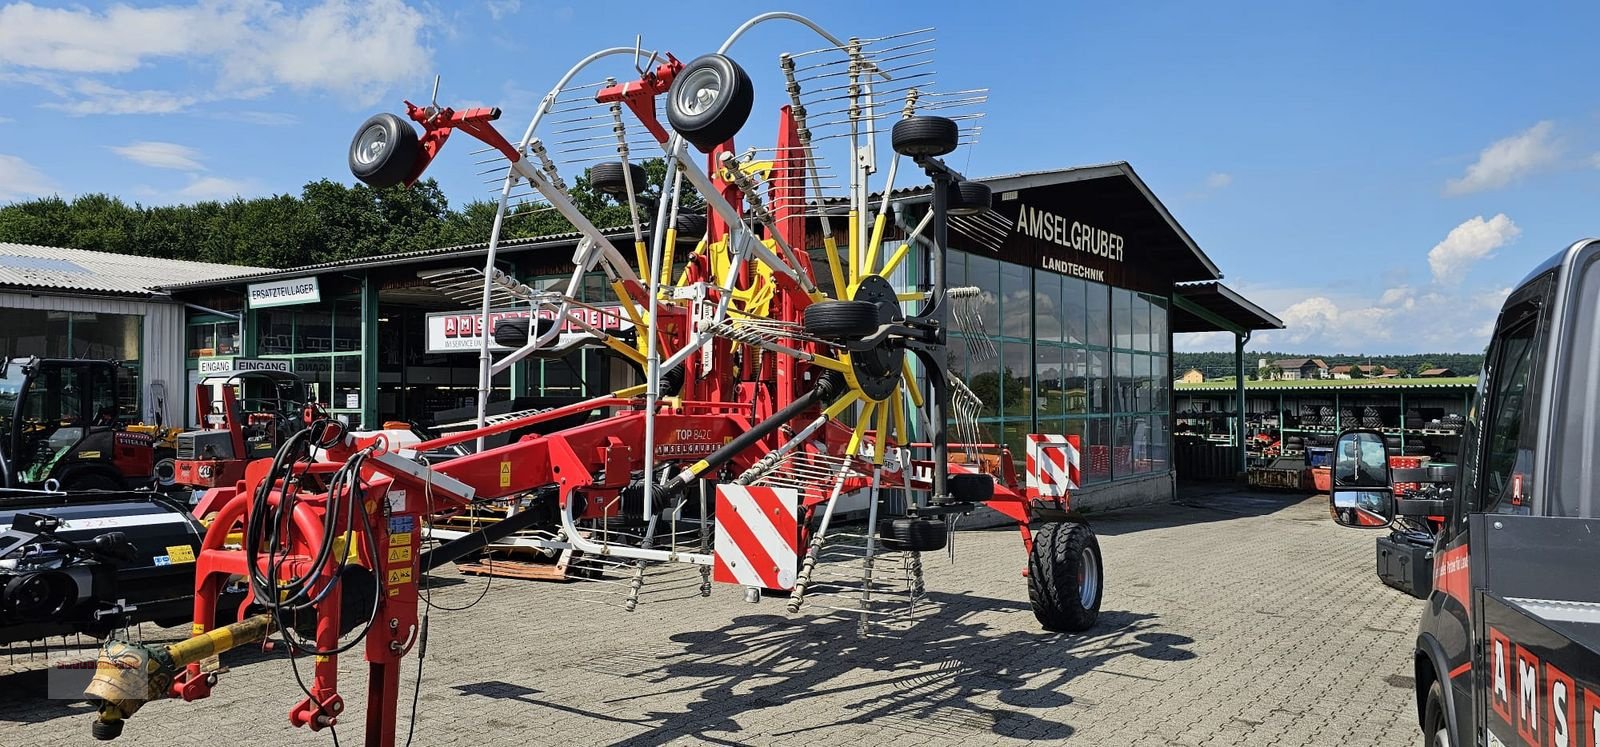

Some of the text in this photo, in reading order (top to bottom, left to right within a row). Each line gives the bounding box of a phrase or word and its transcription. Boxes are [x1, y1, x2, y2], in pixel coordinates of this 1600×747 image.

[1017, 203, 1124, 262] AMSELGRUBER
[1042, 256, 1105, 282] LANDTECHNIK
[252, 283, 314, 300] ERSATZTEILLAGER
[201, 361, 229, 372] EINGANG
[238, 361, 287, 371] EINGANG
[676, 429, 712, 440] TOP 842C
[1494, 639, 1600, 747] AMS
